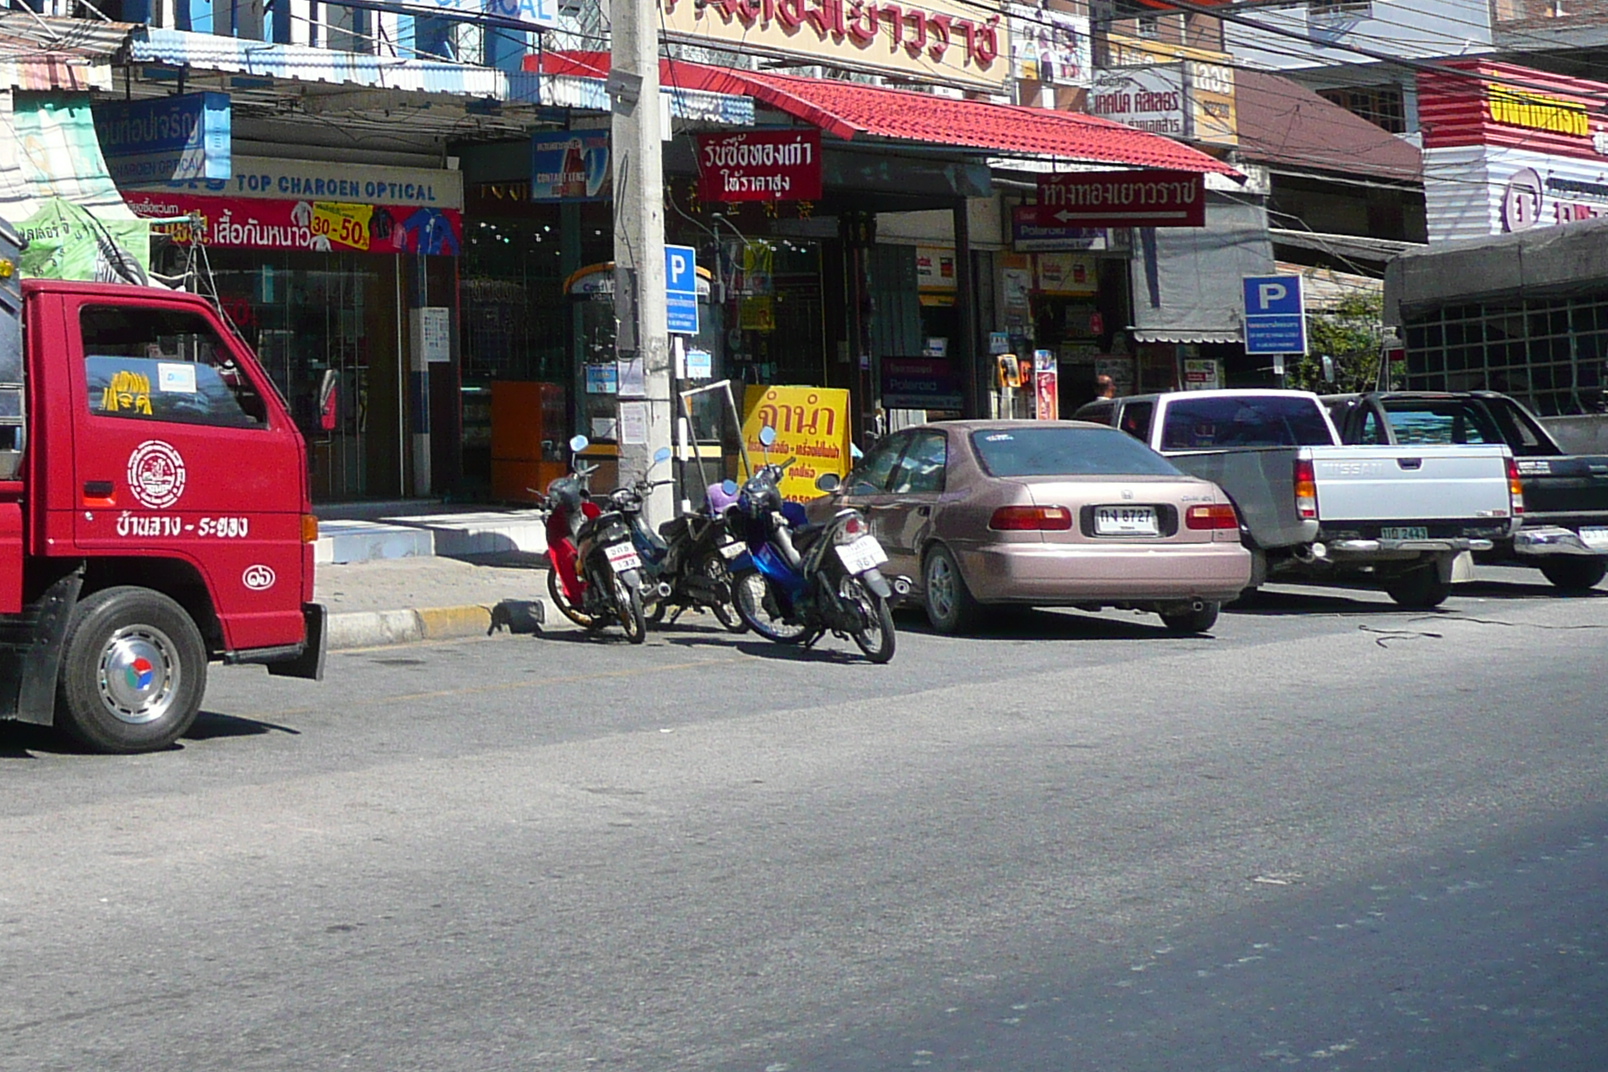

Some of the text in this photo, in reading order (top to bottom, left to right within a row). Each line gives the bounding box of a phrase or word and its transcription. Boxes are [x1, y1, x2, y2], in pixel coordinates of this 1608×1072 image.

[98, 102, 200, 146] ว่นท็อปเจริญ
[158, 155, 204, 174] OPTICAL
[704, 133, 812, 168] รับซื้อทองเก่า
[236, 174, 436, 203] TOP CHAROEN OPTICAL
[720, 169, 791, 197] ให้ราคาสูง
[1042, 175, 1197, 206] ห้างทองเยาวราช
[213, 209, 311, 247] เสื้อกันหนาว
[312, 216, 330, 235] 30
[339, 218, 369, 248] 50%
[671, 254, 685, 284] P
[1258, 283, 1287, 310] P
[757, 390, 836, 436] จำนำ
[196, 516, 249, 539] ระยอง
